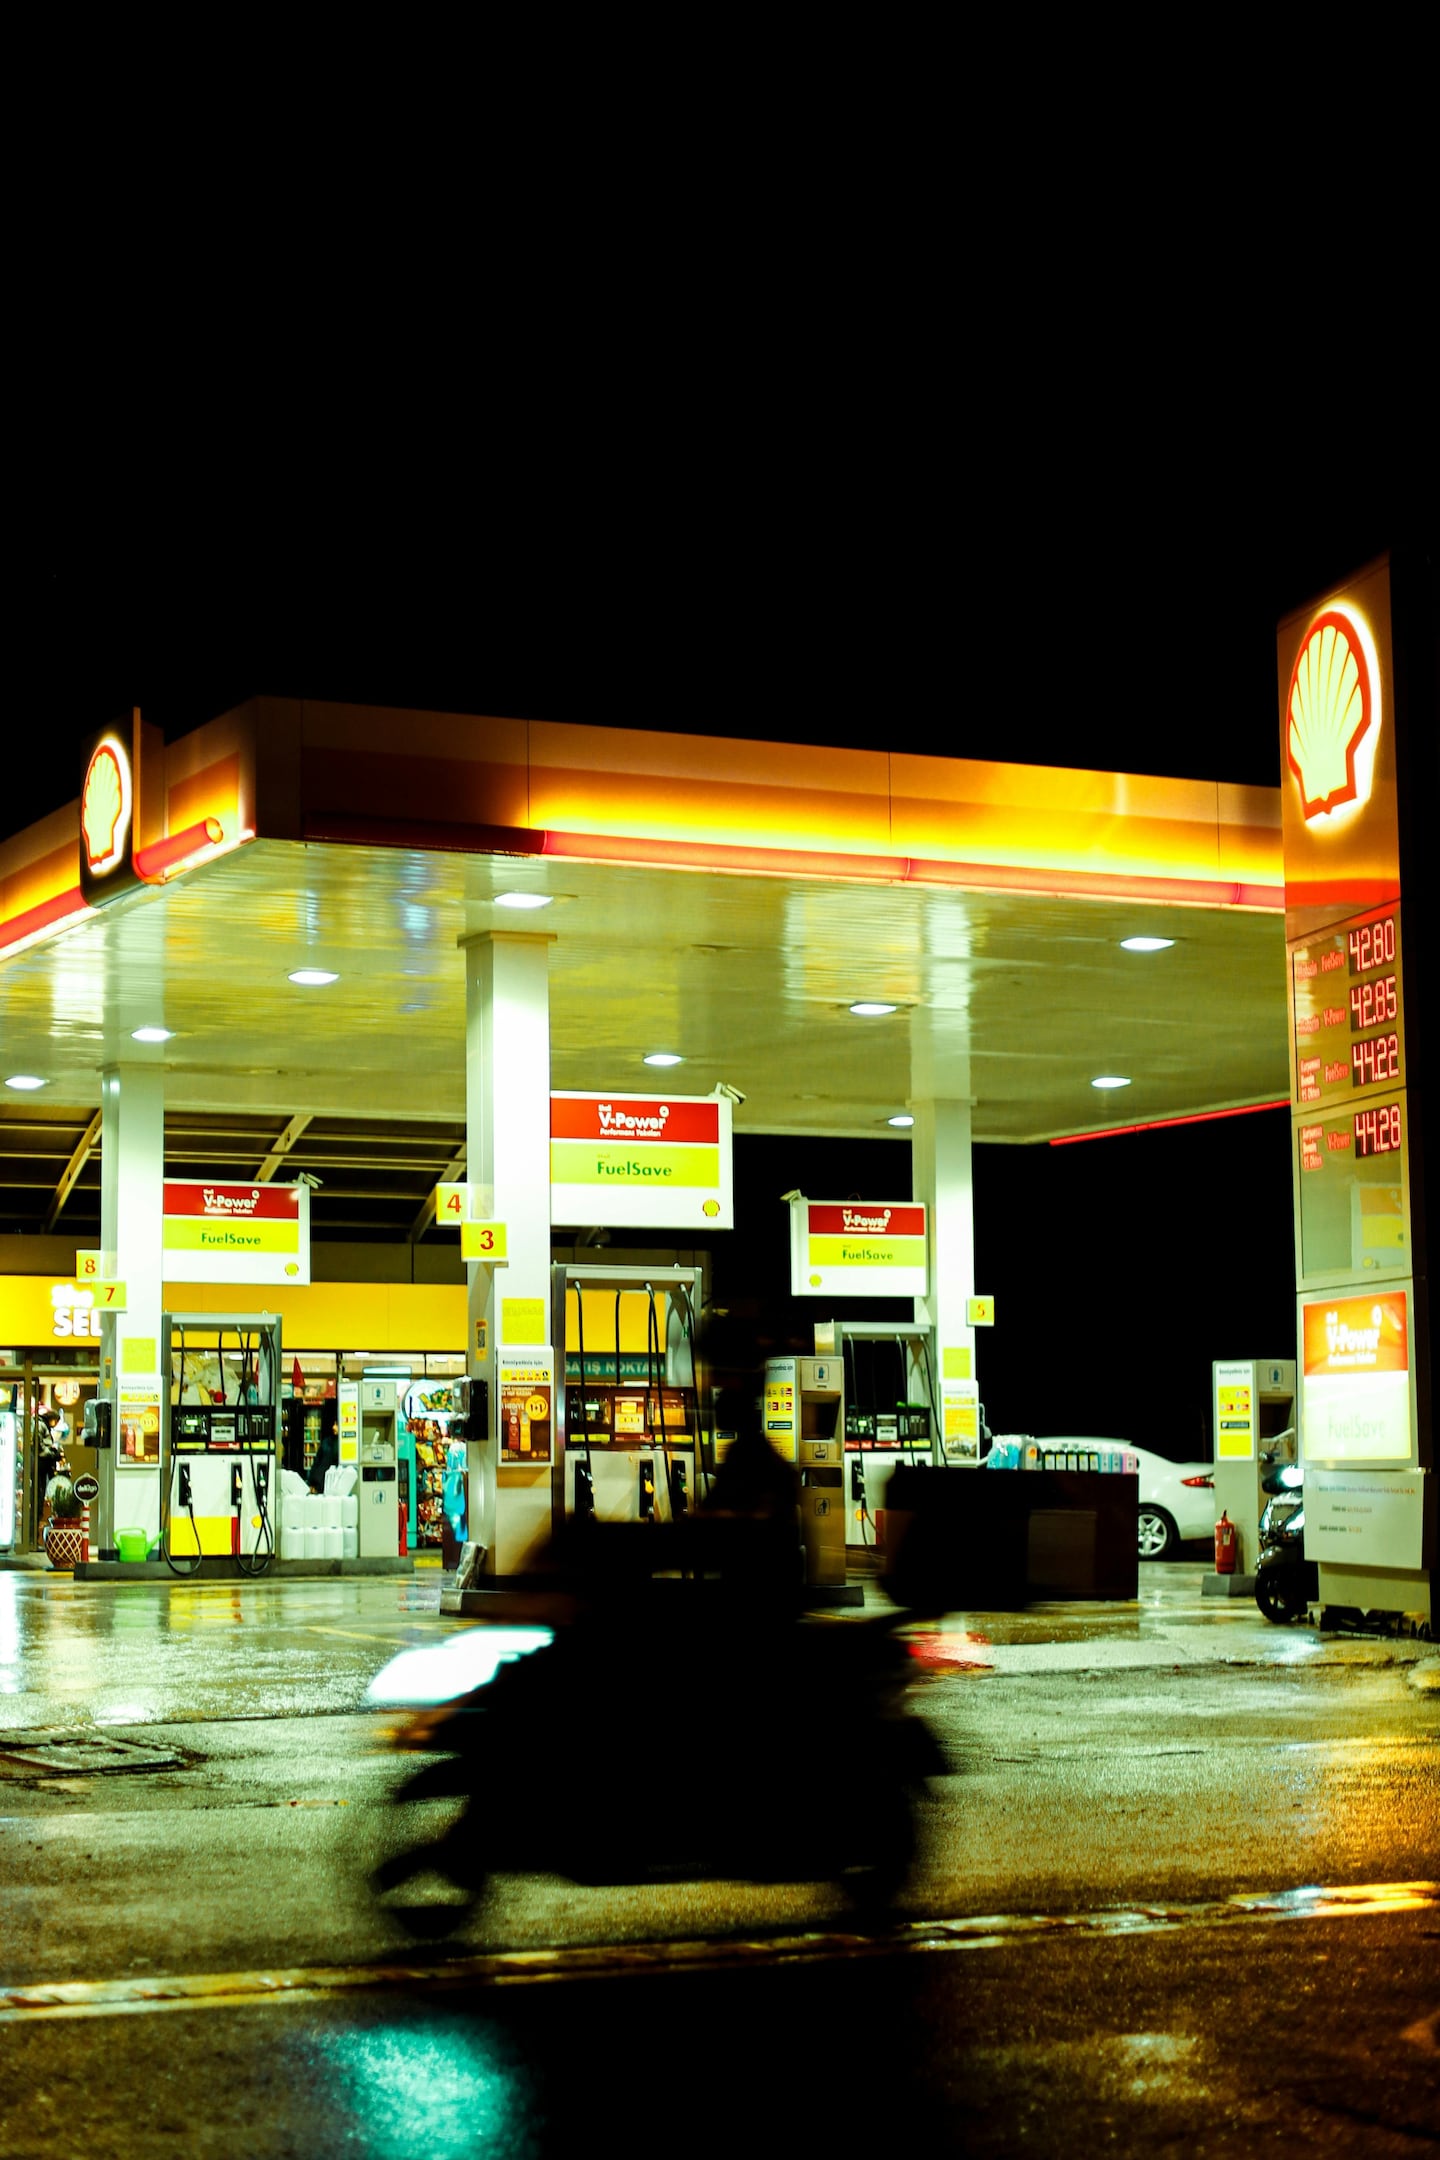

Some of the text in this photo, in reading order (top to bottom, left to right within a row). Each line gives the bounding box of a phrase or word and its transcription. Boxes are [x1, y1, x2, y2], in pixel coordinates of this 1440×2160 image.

[1349, 918, 1396, 972] 42.80
[1351, 975, 1398, 1028] 42.85
[1353, 1033, 1400, 1085] 44.22
[598, 1112, 666, 1130] V-Power
[1355, 1104, 1401, 1155] 44.28
[597, 1161, 672, 1177] FuelSave
[203, 1194, 257, 1209] V-Power
[447, 1193, 462, 1213] 4
[843, 1214, 889, 1228] V-Power
[202, 1232, 261, 1245] FuelSave
[480, 1229, 494, 1250] 3
[842, 1249, 893, 1261] FuelSave
[85, 1258, 96, 1274] 8
[104, 1287, 115, 1302] 7
[977, 1303, 986, 1317] 5
[1328, 1415, 1385, 1438] FuelSave
